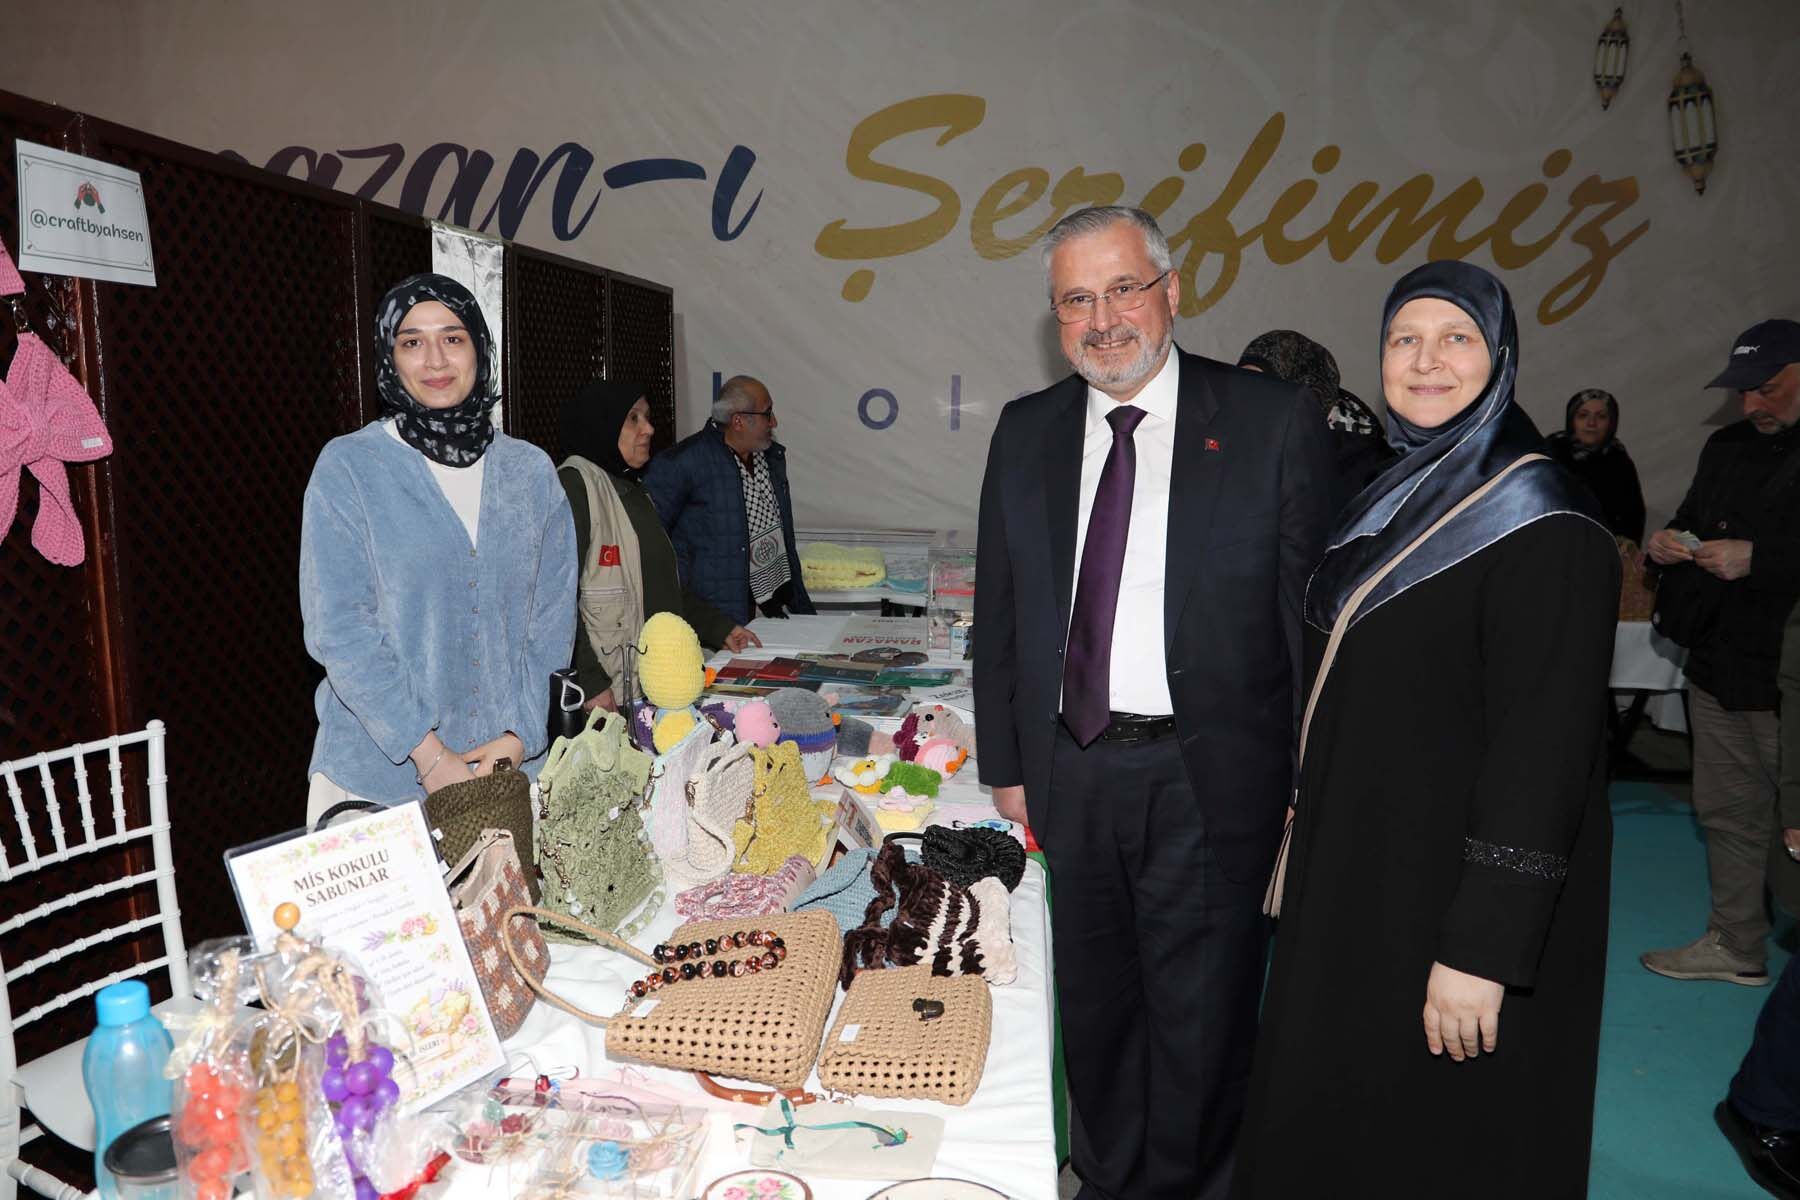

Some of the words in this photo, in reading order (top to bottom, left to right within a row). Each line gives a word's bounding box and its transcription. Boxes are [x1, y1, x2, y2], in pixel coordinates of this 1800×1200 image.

[30, 208, 144, 242] @craftbyahsen
[814, 93, 1650, 326] Şerifimiz
[293, 871, 325, 894] MİS
[327, 848, 390, 882] KOKULU
[305, 867, 390, 907] SABUNLAR
